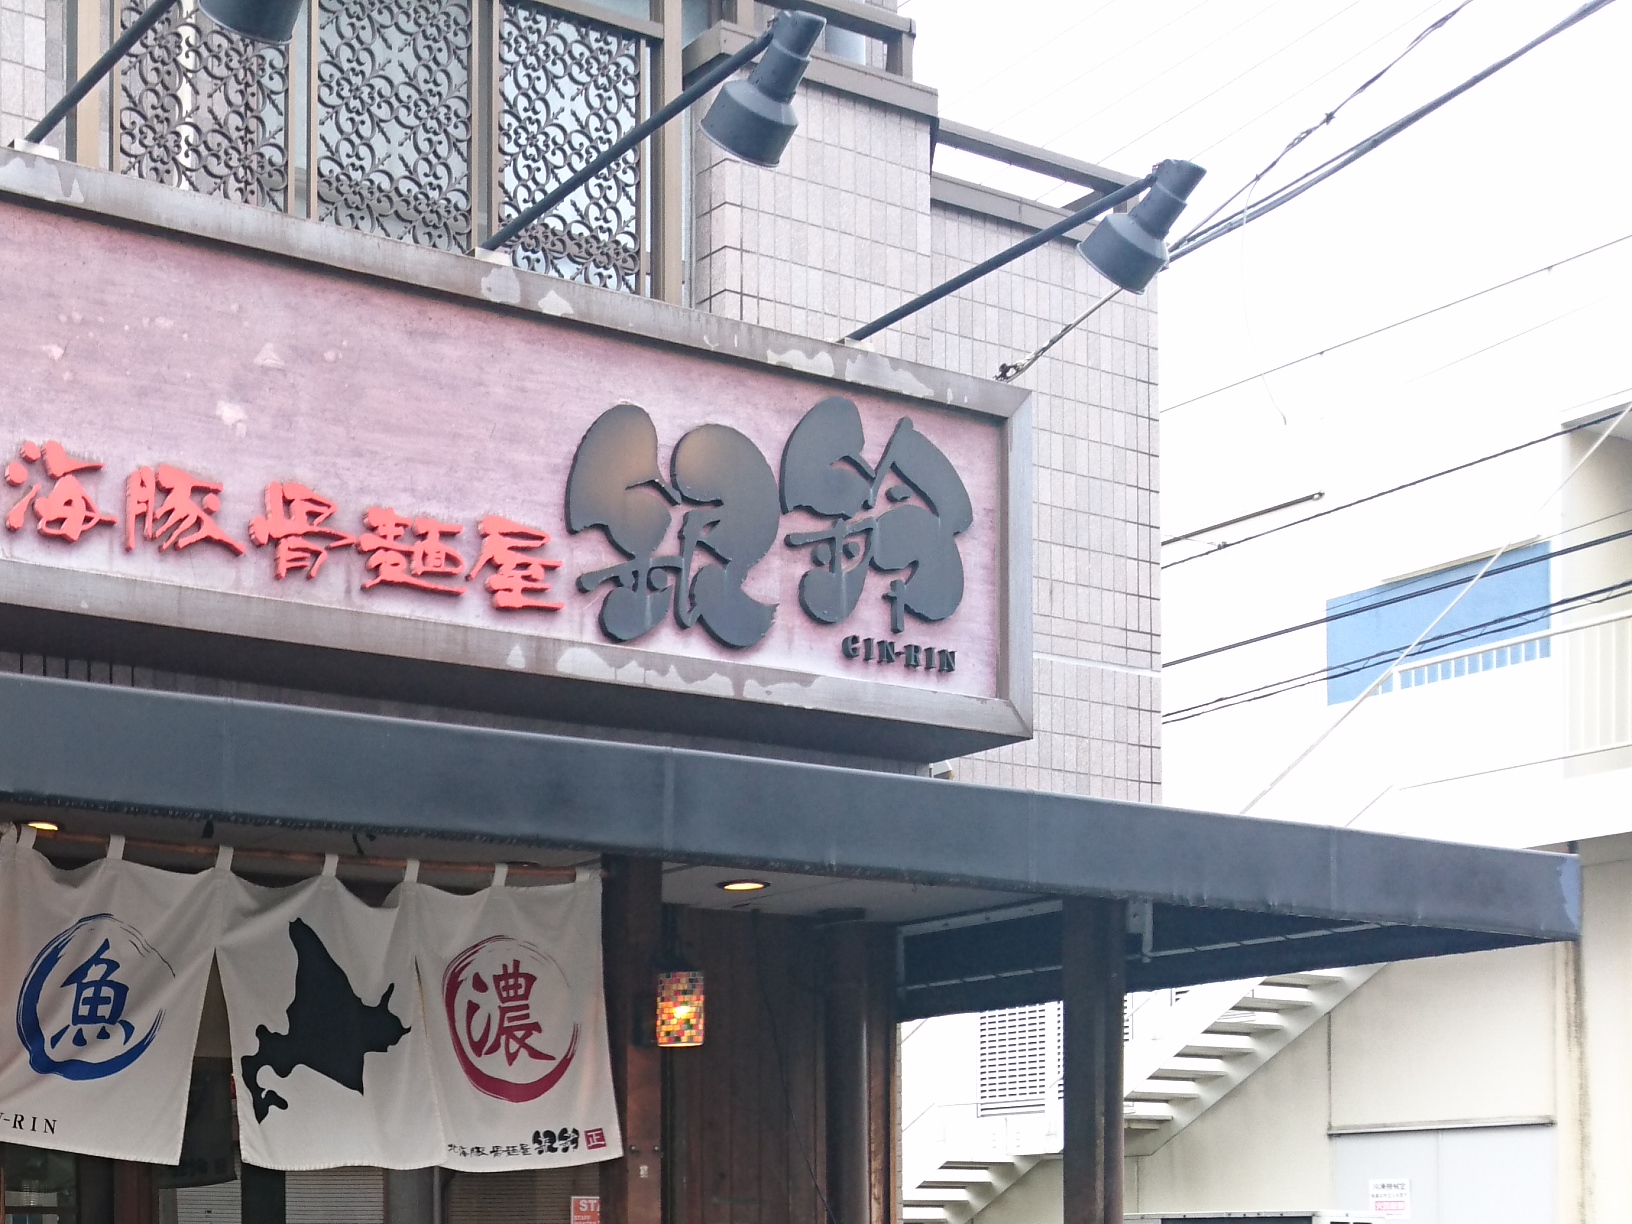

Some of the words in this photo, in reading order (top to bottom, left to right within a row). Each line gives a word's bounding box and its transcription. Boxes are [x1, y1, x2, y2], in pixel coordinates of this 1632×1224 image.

[841, 634, 957, 673] GIN-RIN
[50, 938, 132, 1048] 魚
[466, 958, 558, 1068] 濃
